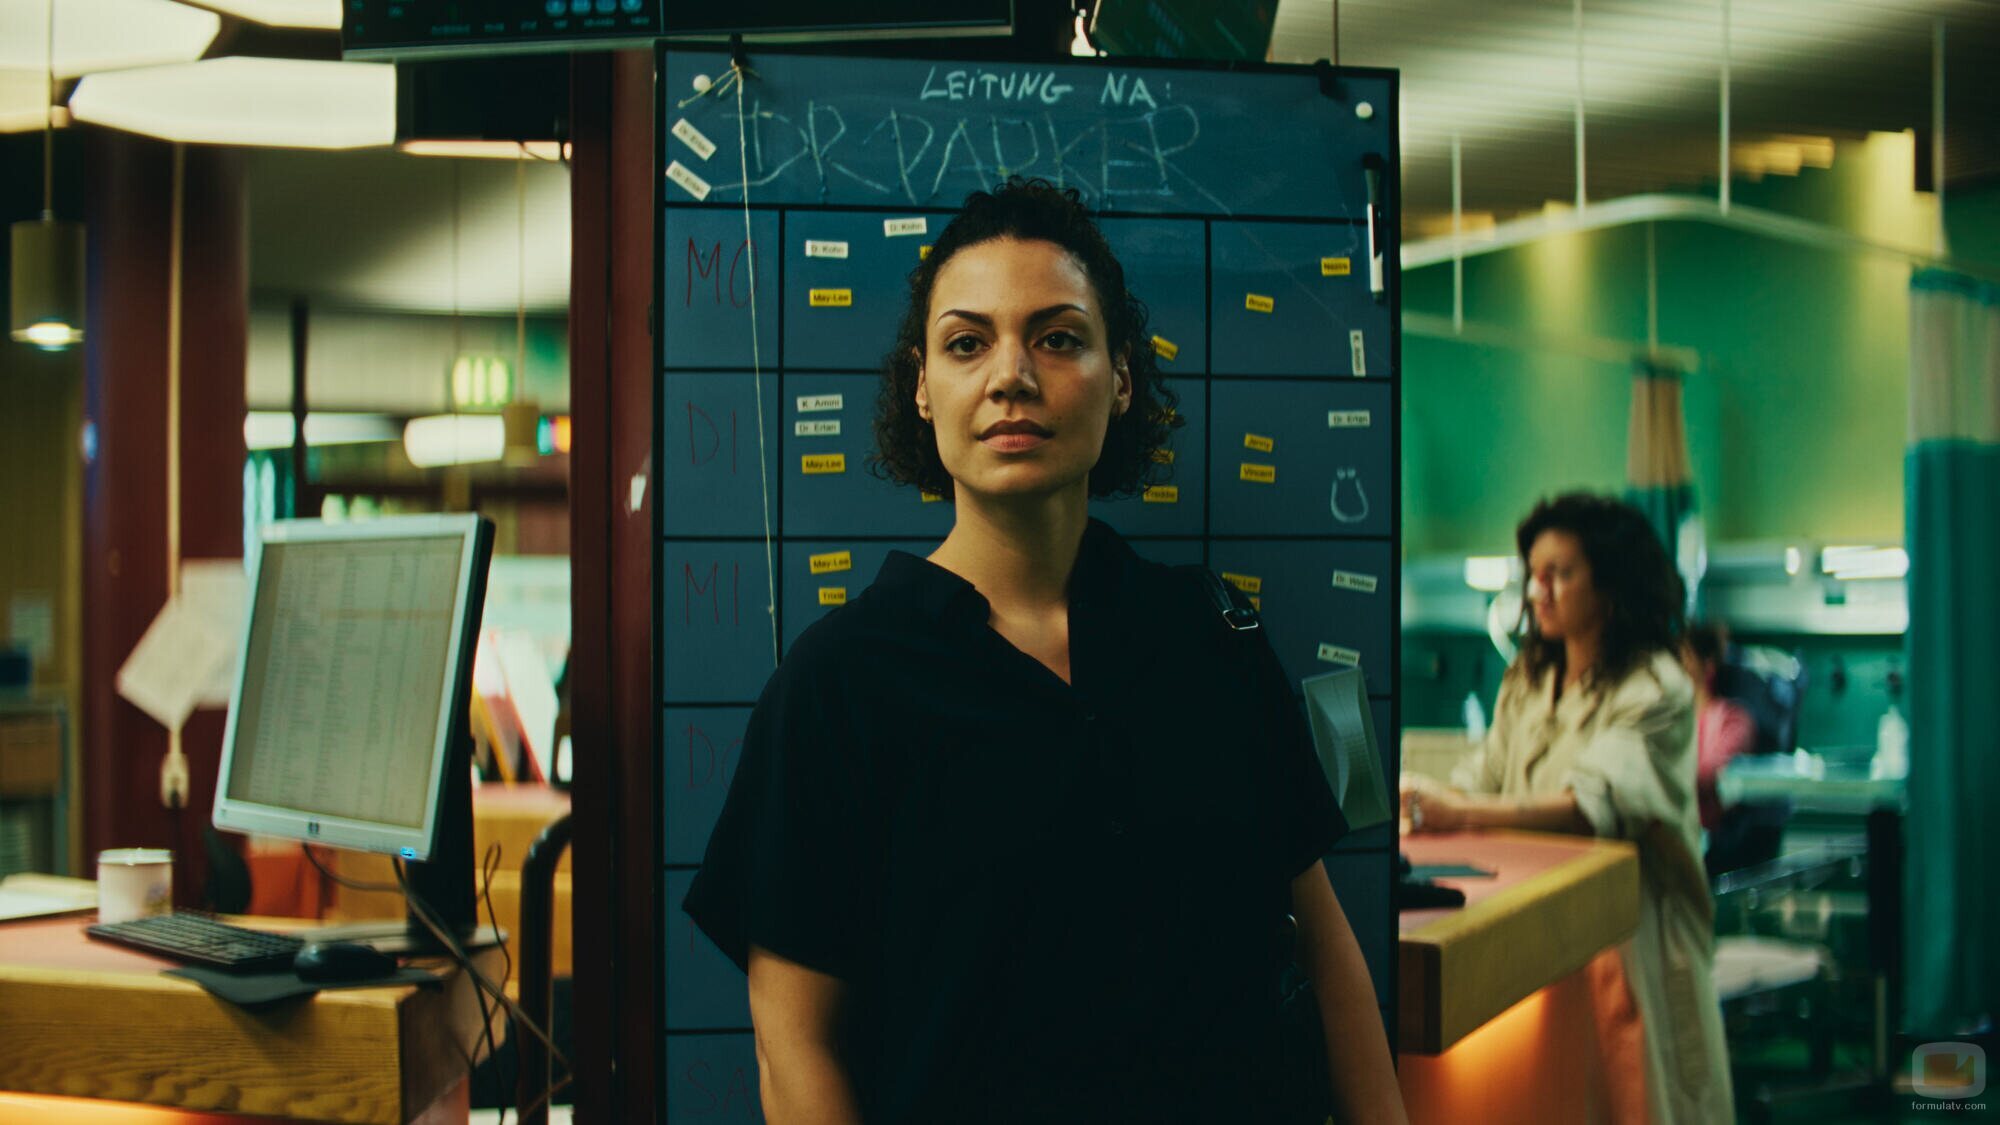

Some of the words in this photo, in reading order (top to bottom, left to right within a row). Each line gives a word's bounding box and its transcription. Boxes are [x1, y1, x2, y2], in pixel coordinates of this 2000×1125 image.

[687, 237, 758, 308] MO
[687, 400, 738, 475] DI
[685, 561, 739, 625] MI
